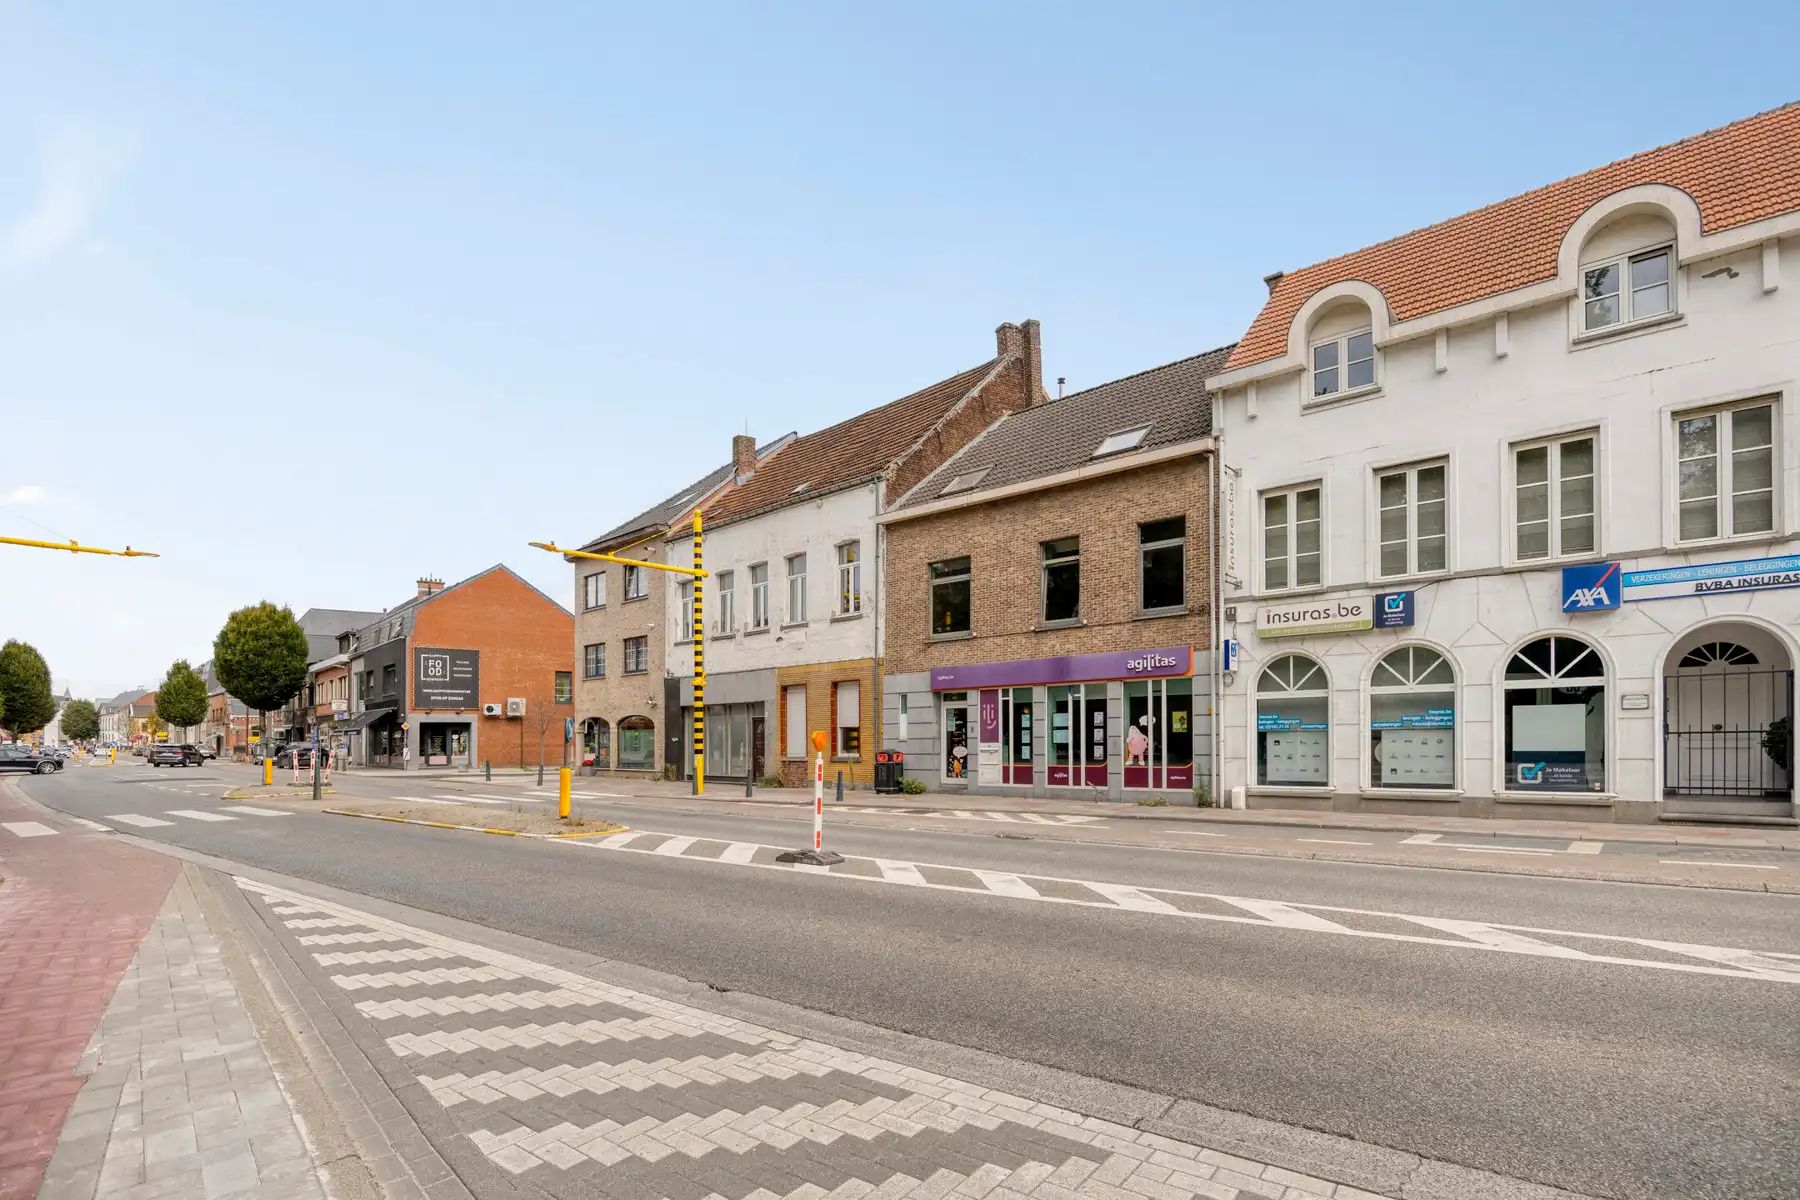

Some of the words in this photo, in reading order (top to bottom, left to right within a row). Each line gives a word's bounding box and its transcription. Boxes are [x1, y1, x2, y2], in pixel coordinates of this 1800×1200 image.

[1631, 570, 1691, 583] VERZEKERINGEN
[1698, 566, 1737, 577] LENINGEN
[1744, 560, 1800, 572] BELEGGINGEN
[1695, 579, 1734, 592] BVBA
[1737, 573, 1800, 588] INSURAS
[1563, 587, 1610, 608] AXA
[1265, 603, 1362, 624] insuras.be
[1127, 653, 1176, 671] agilitas
